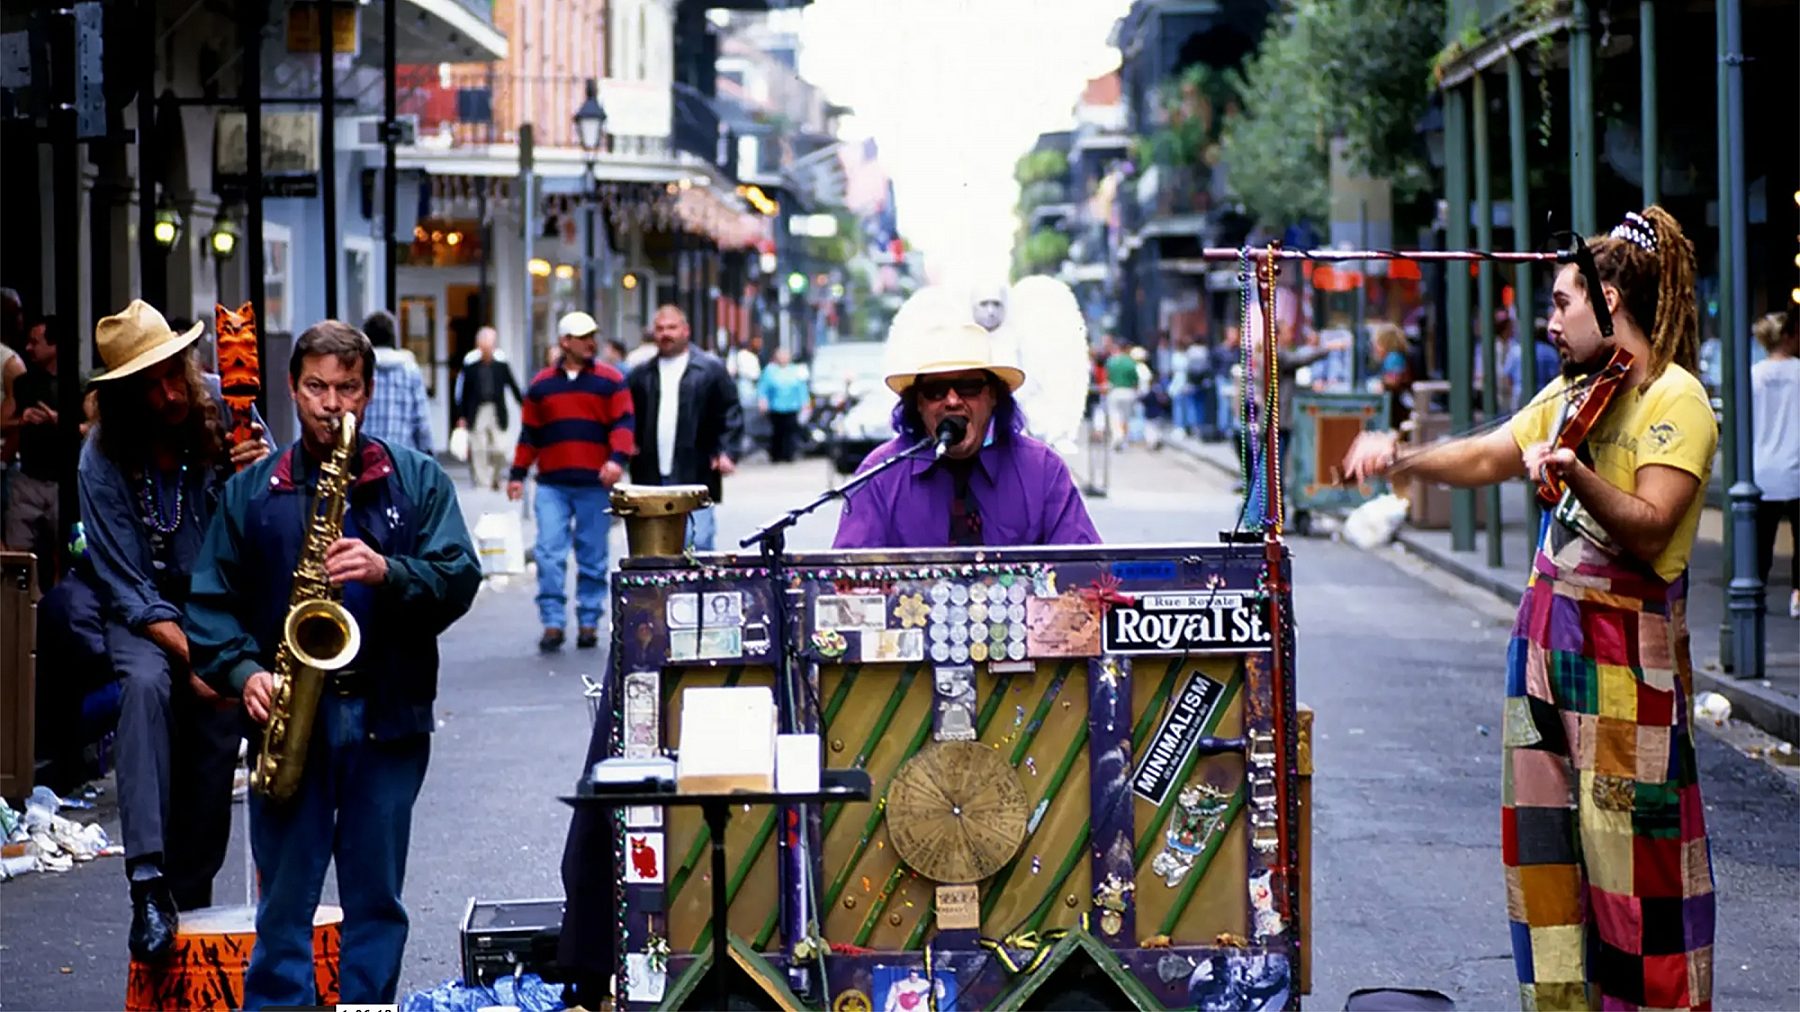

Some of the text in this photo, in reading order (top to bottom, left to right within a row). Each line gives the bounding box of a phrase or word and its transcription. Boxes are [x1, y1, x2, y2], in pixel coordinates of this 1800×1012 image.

[1156, 597, 1236, 606] Rue Royale
[1115, 608, 1271, 649] Royal St.
[1137, 676, 1210, 792] MINIMALISM
